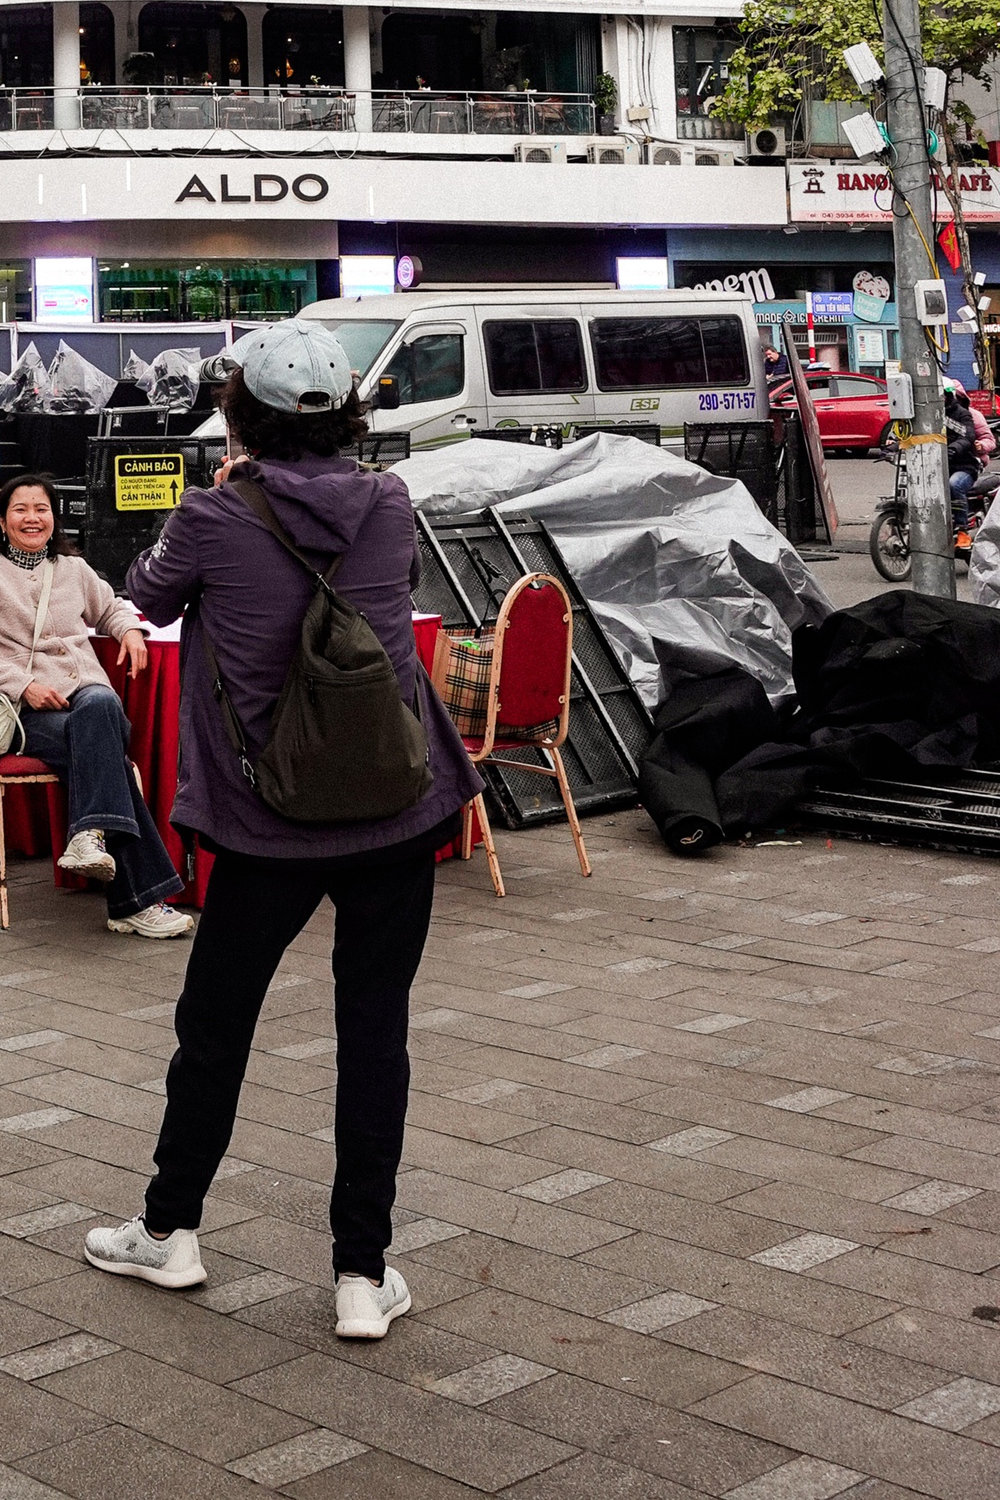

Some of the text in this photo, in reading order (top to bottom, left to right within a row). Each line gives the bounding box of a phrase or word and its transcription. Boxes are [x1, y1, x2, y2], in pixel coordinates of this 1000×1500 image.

[174, 173, 330, 203] ALDO
[632, 399, 658, 410] ESP
[154, 459, 175, 472] BÁO
